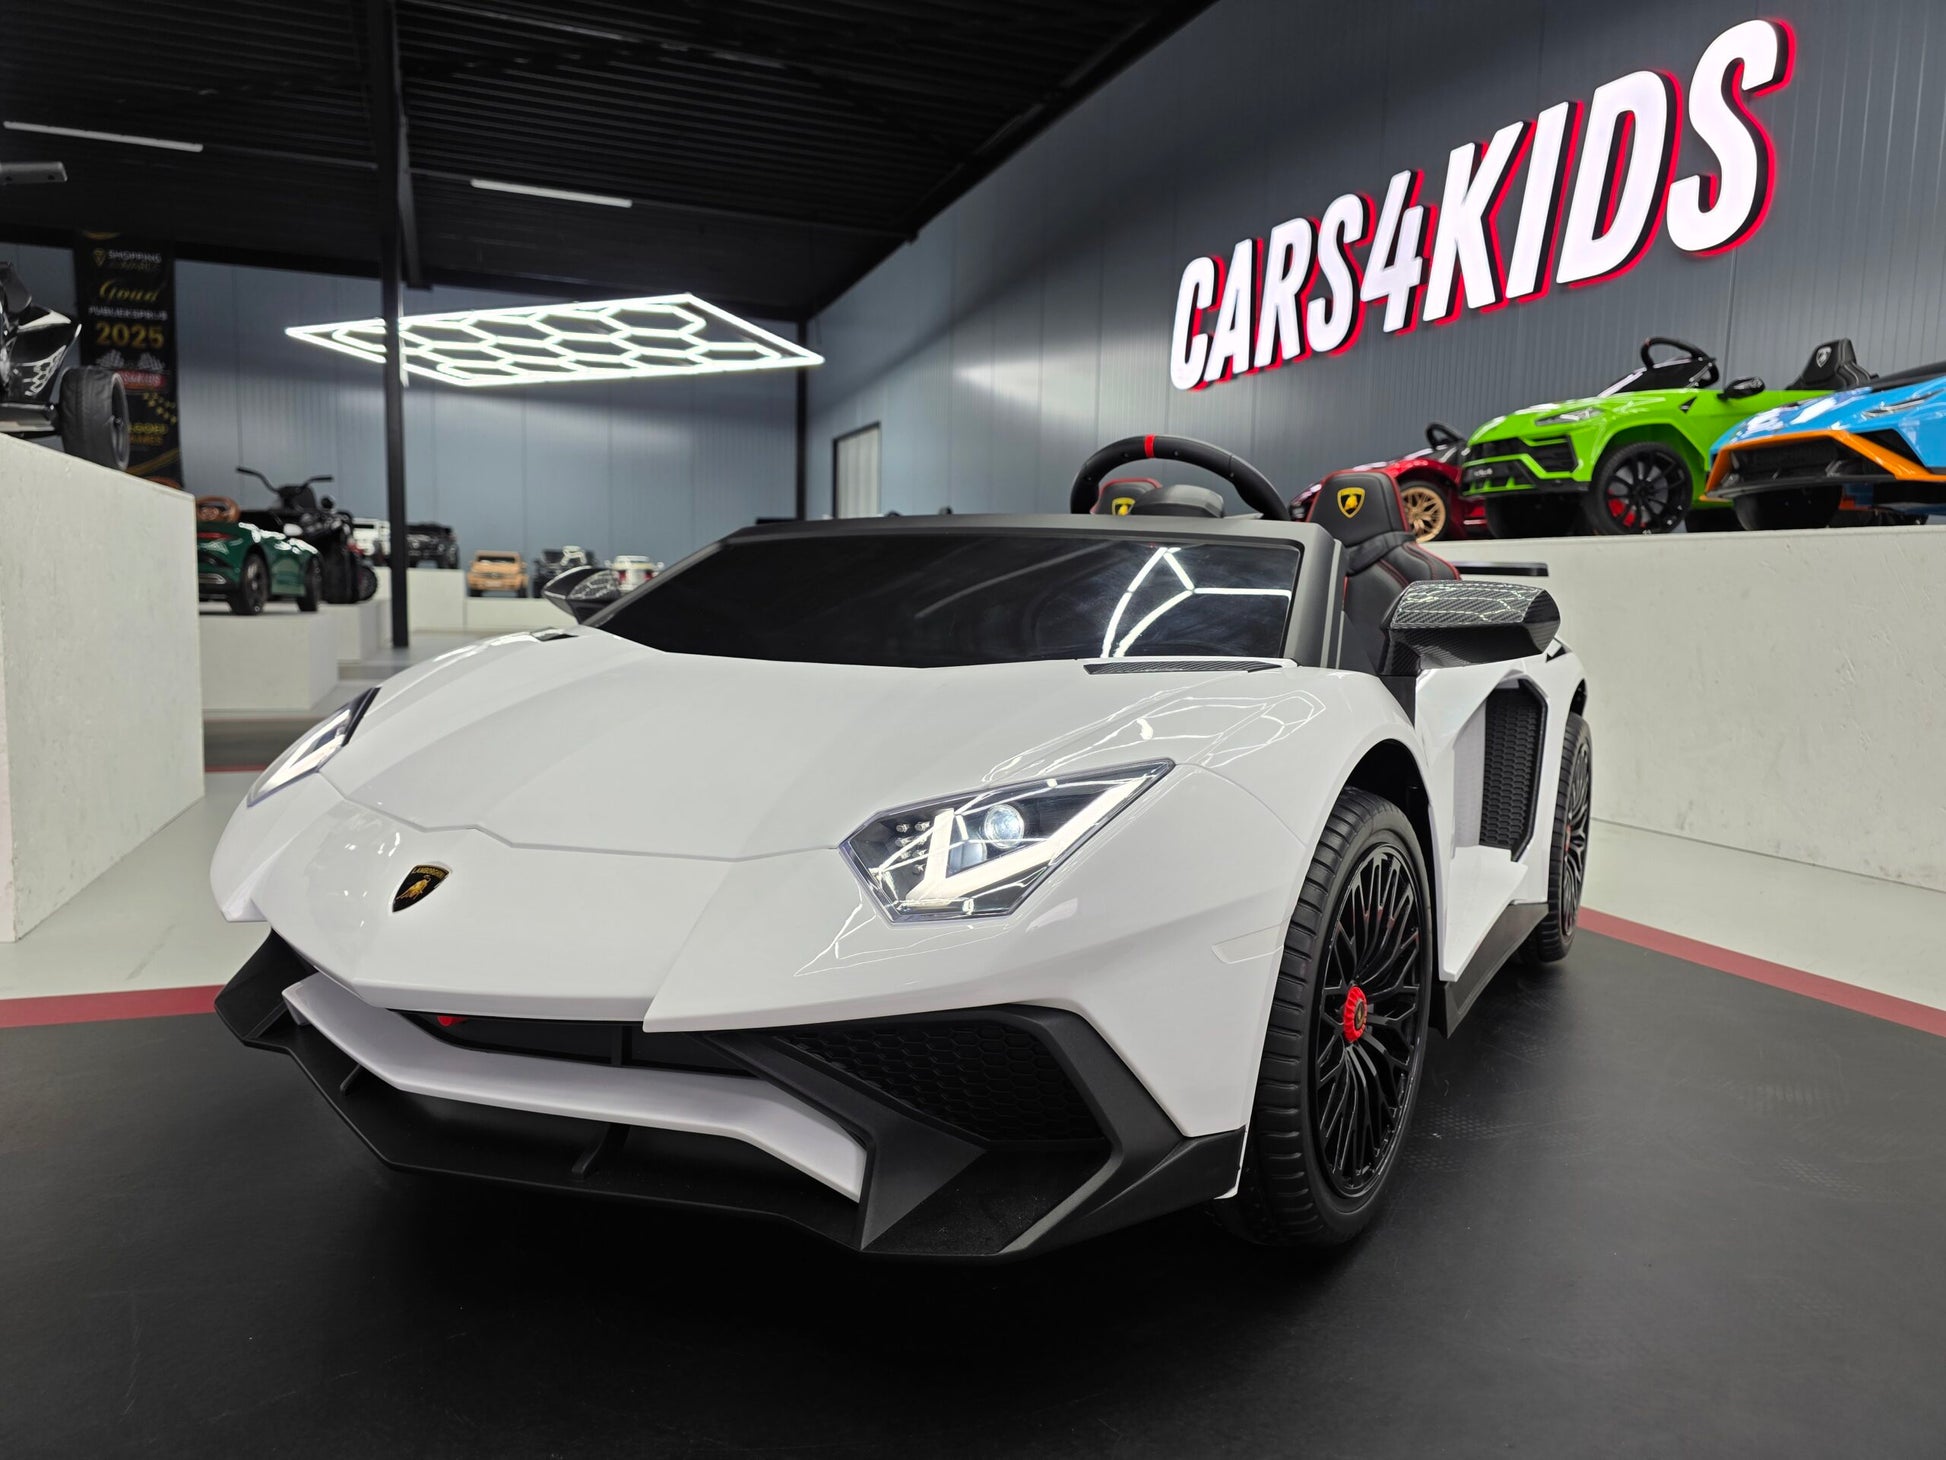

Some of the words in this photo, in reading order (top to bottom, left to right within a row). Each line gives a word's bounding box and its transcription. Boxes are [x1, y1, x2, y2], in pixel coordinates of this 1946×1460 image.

[1170, 19, 1790, 391] CARS4KIDS
[107, 249, 162, 264] SHOPPING
[95, 322, 165, 350] 2025
